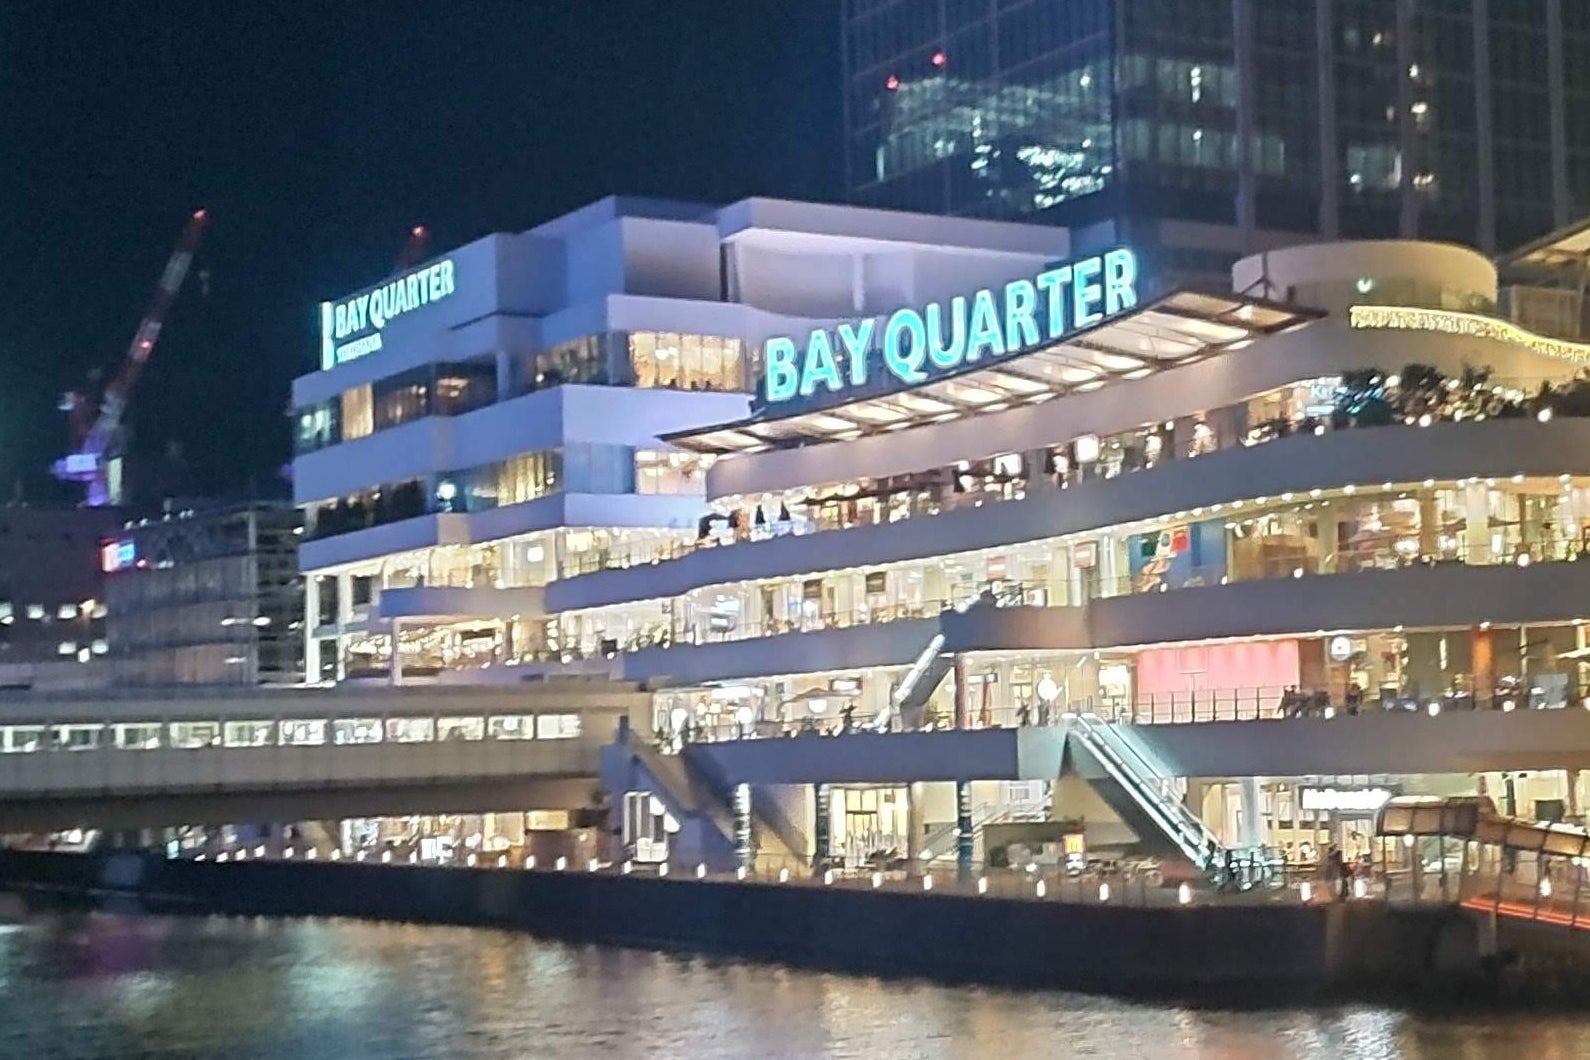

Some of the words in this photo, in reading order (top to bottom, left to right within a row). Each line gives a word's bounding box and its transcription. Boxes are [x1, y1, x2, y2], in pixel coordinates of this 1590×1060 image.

[335, 294, 370, 339] BAY
[368, 259, 455, 329] QUARTER
[766, 317, 876, 401] BAY
[883, 248, 1138, 385] QUARTER
